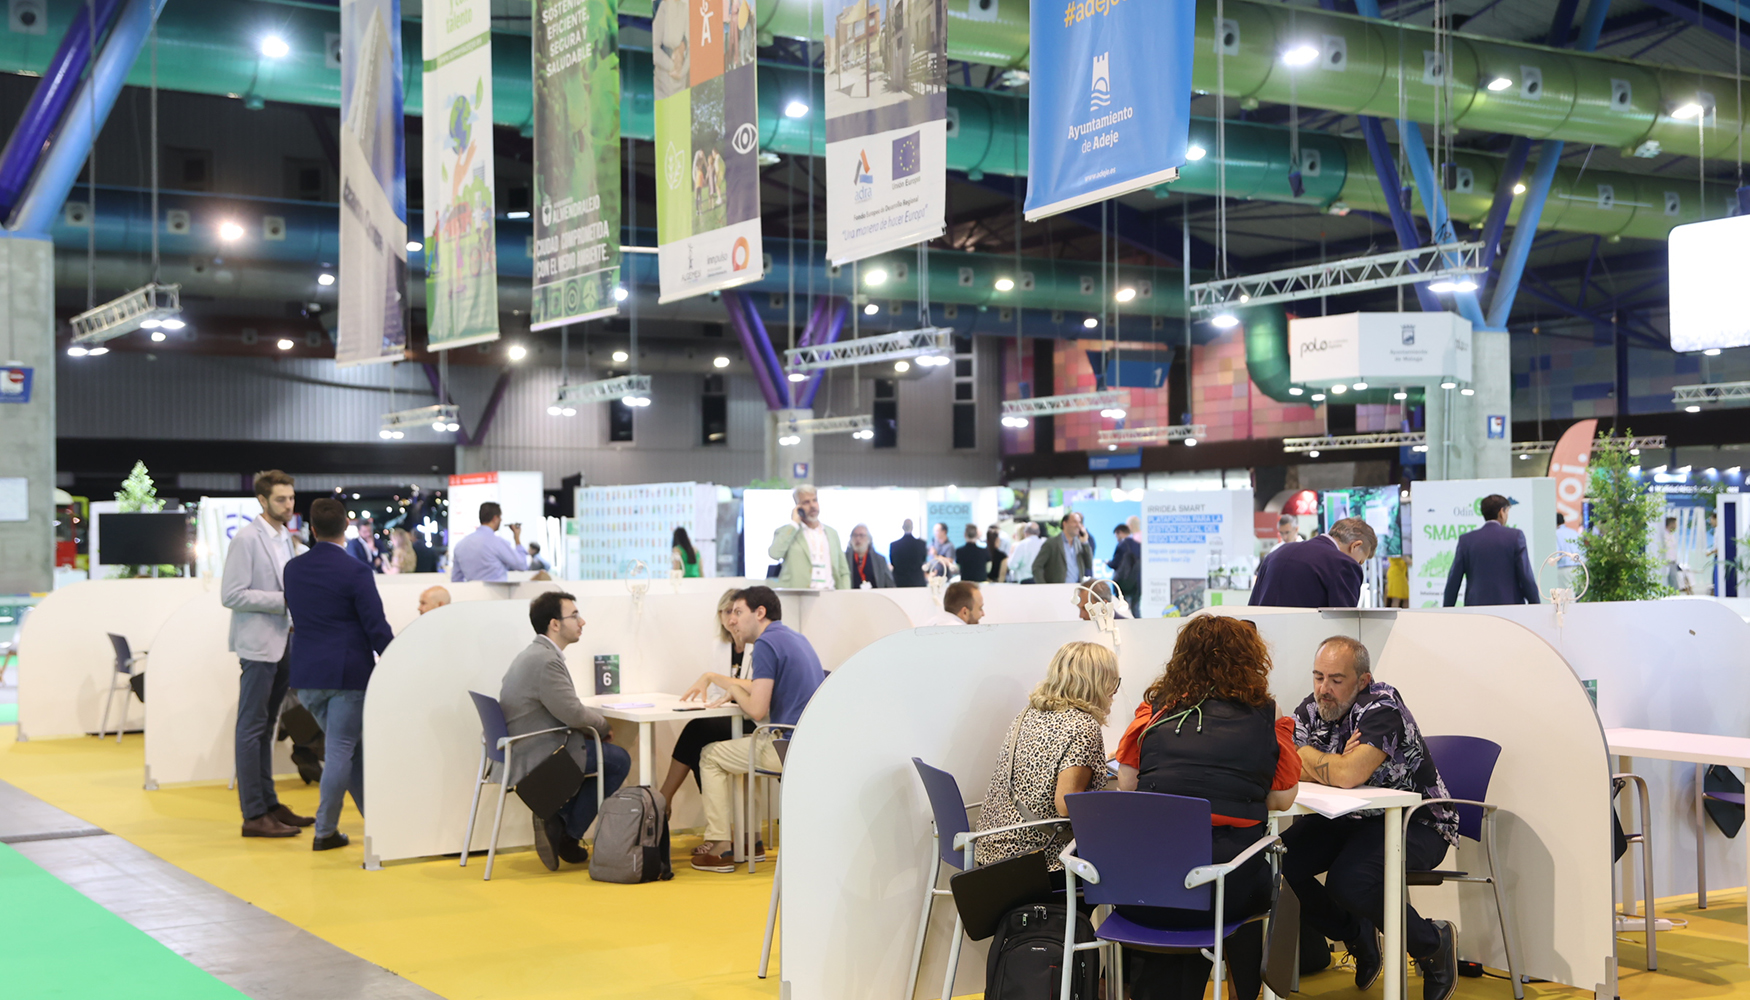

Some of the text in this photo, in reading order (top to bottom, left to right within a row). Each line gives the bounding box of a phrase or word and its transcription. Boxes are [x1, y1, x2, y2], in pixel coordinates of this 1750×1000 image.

[446, 8, 473, 34] talento
[547, 7, 590, 40] EFICIENTE,
[1064, 0, 1127, 28] #adej
[550, 25, 588, 57] SEGURA Y
[546, 43, 592, 77] SALUDABLE
[1068, 106, 1133, 140] Ayuntamiento
[1081, 130, 1119, 154] de Adeje
[1084, 167, 1116, 182] www.adeje.es
[854, 186, 872, 201] adra
[1301, 338, 1328, 358] polo
[1153, 367, 1162, 387] 1
[1552, 453, 1588, 523] voi.
[930, 504, 969, 515] GECOR
[1147, 504, 1205, 513] IRRIDEA SMART
[1148, 514, 1222, 523] PLATAFORMA PARA LA
[603, 672, 612, 686] 6
